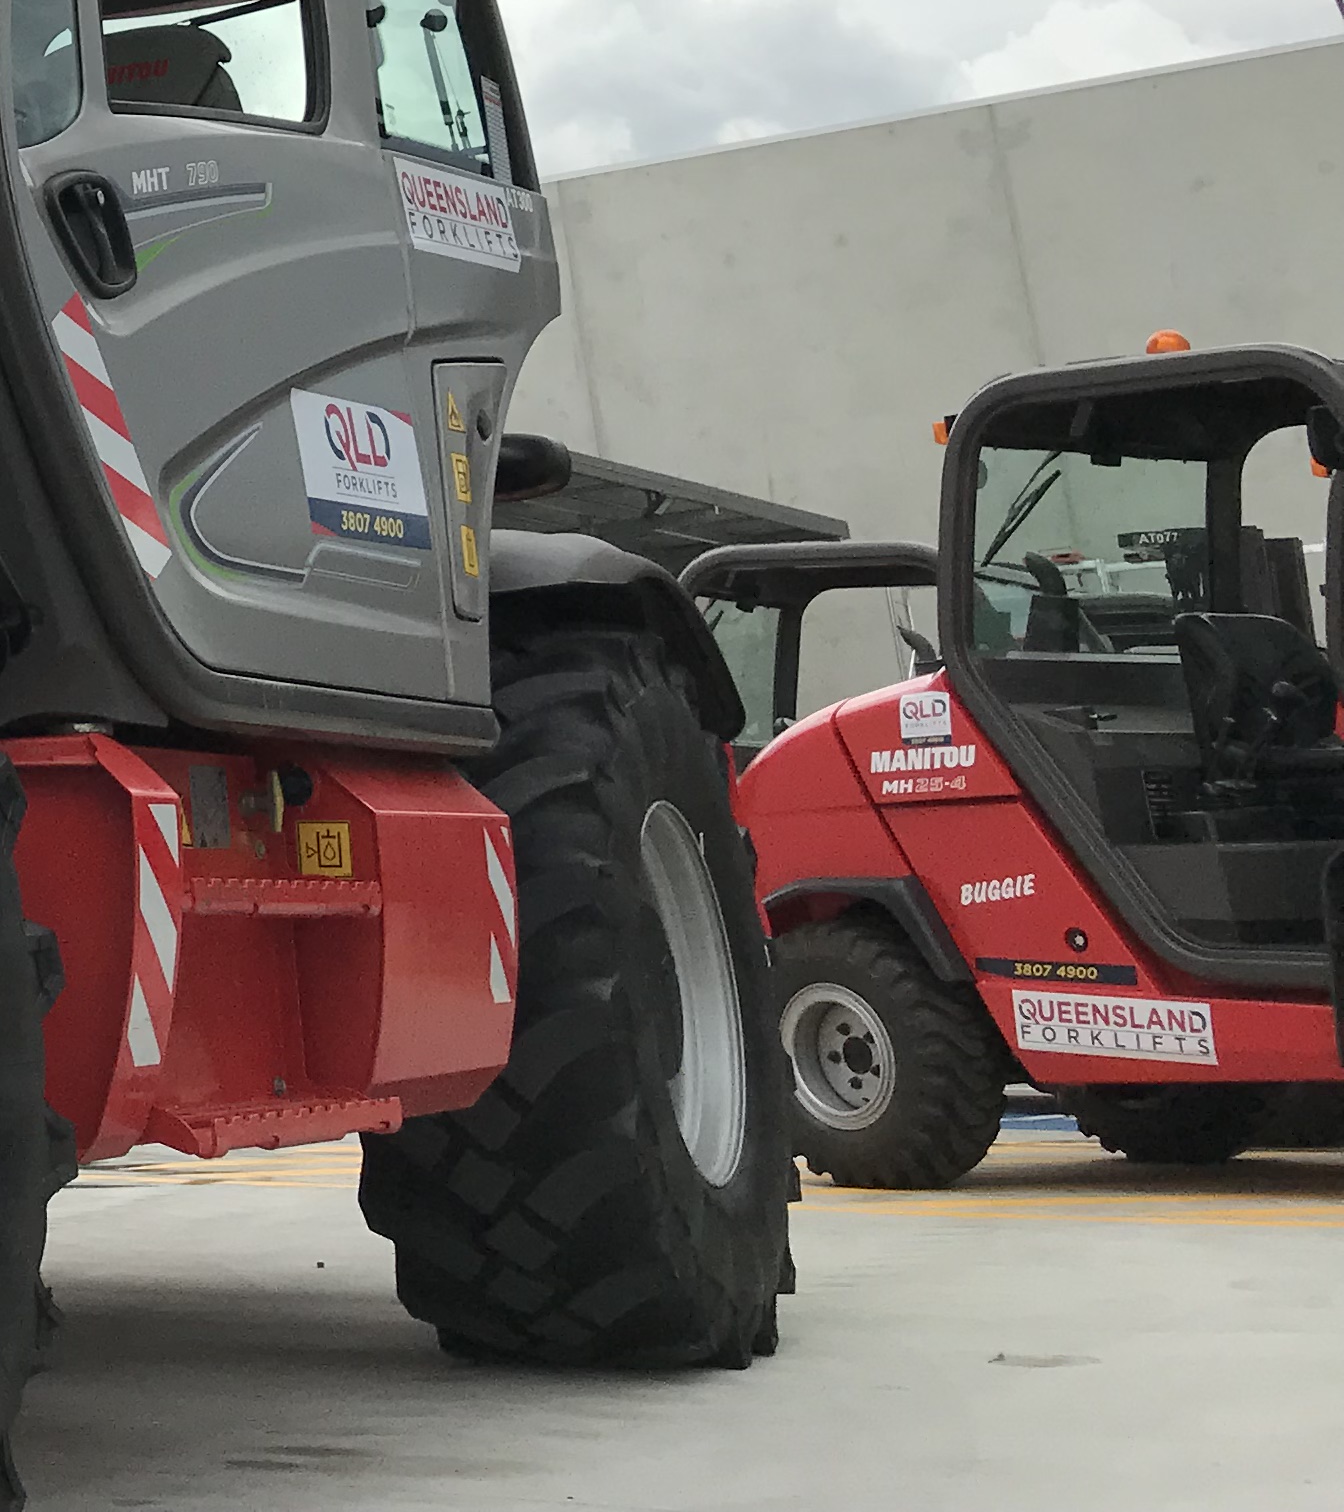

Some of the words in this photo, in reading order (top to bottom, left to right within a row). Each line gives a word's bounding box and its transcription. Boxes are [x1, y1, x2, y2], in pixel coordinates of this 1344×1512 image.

[132, 166, 170, 195] MHT
[186, 159, 220, 186] 790
[401, 171, 509, 229] QUEENSLAND
[408, 211, 519, 259] FORKLIFTS
[323, 403, 391, 472] QLD
[335, 473, 398, 499] FORKLIFTS
[340, 510, 372, 534] 3807
[373, 515, 405, 540] 4900
[902, 698, 947, 721] QLD
[870, 744, 977, 774] MANITOU
[960, 873, 1036, 906] BUGGIE
[1013, 962, 1053, 977] 3807
[1055, 965, 1099, 980] 4900
[1018, 998, 1208, 1034] QUEENSLAND
[1020, 1024, 1212, 1056] FORKLIFTS
